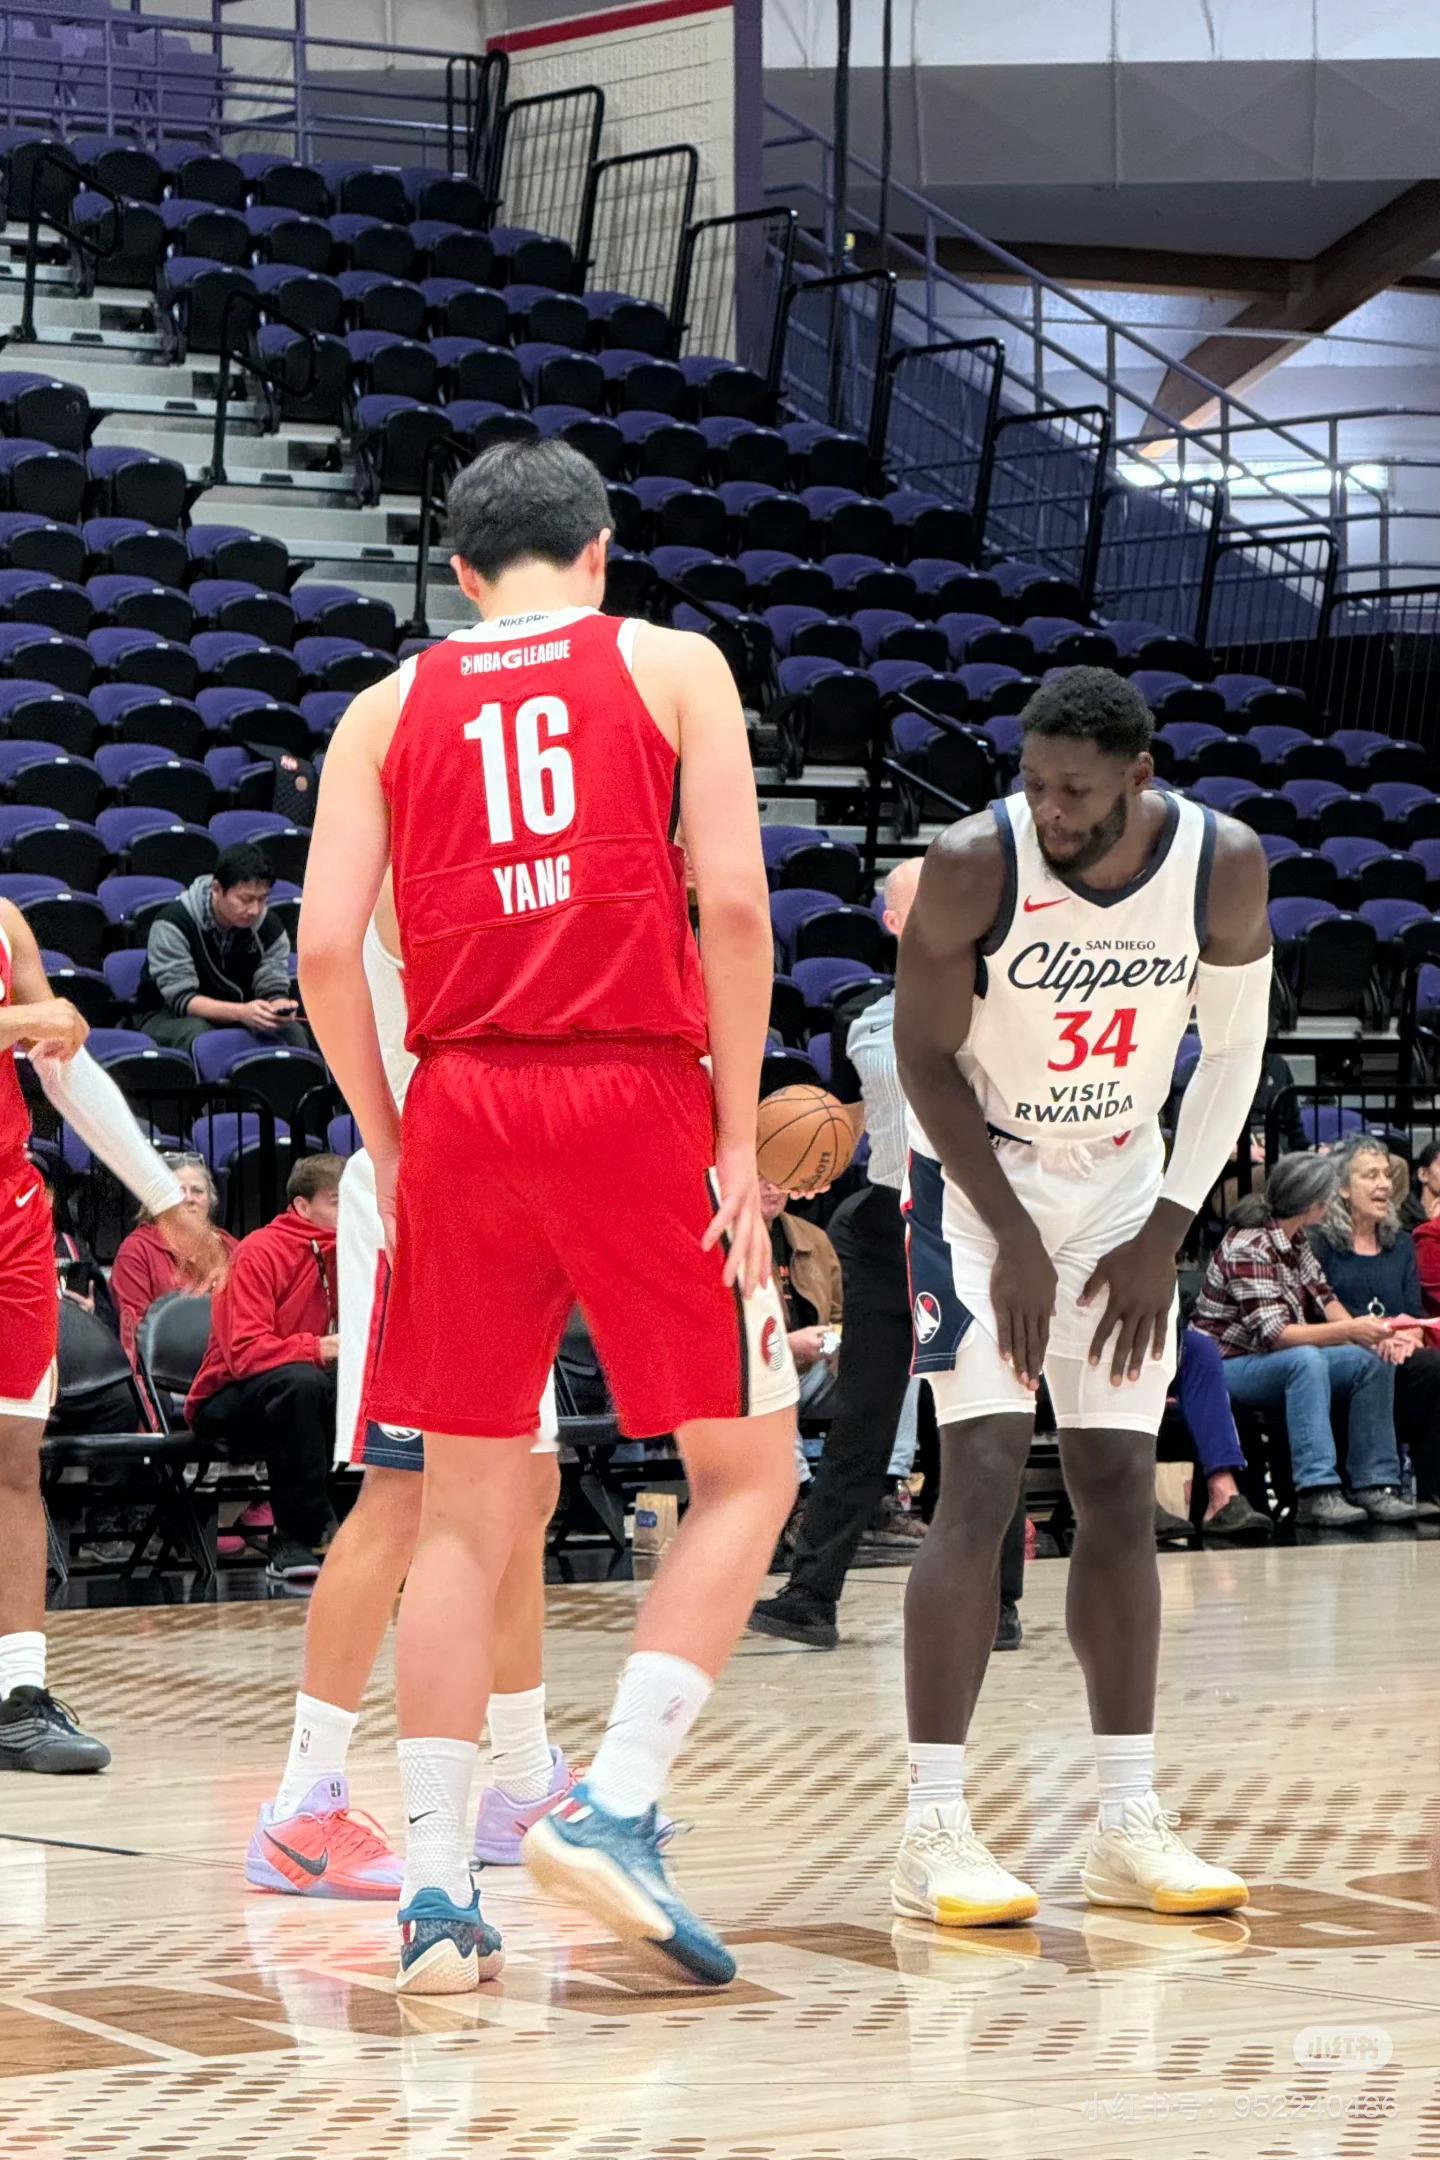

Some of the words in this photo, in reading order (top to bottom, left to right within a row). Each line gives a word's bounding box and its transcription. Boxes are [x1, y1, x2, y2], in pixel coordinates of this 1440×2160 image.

[463, 695, 576, 845] 16
[492, 854, 571, 916] YANG
[1007, 941, 1189, 1004] Clippers
[1085, 939, 1112, 951] SAN
[1114, 939, 1157, 951] DIEGO
[1046, 1007, 1139, 1073] 34
[1014, 1095, 1134, 1123] RWANDA
[1049, 1081, 1120, 1103] VISIT
